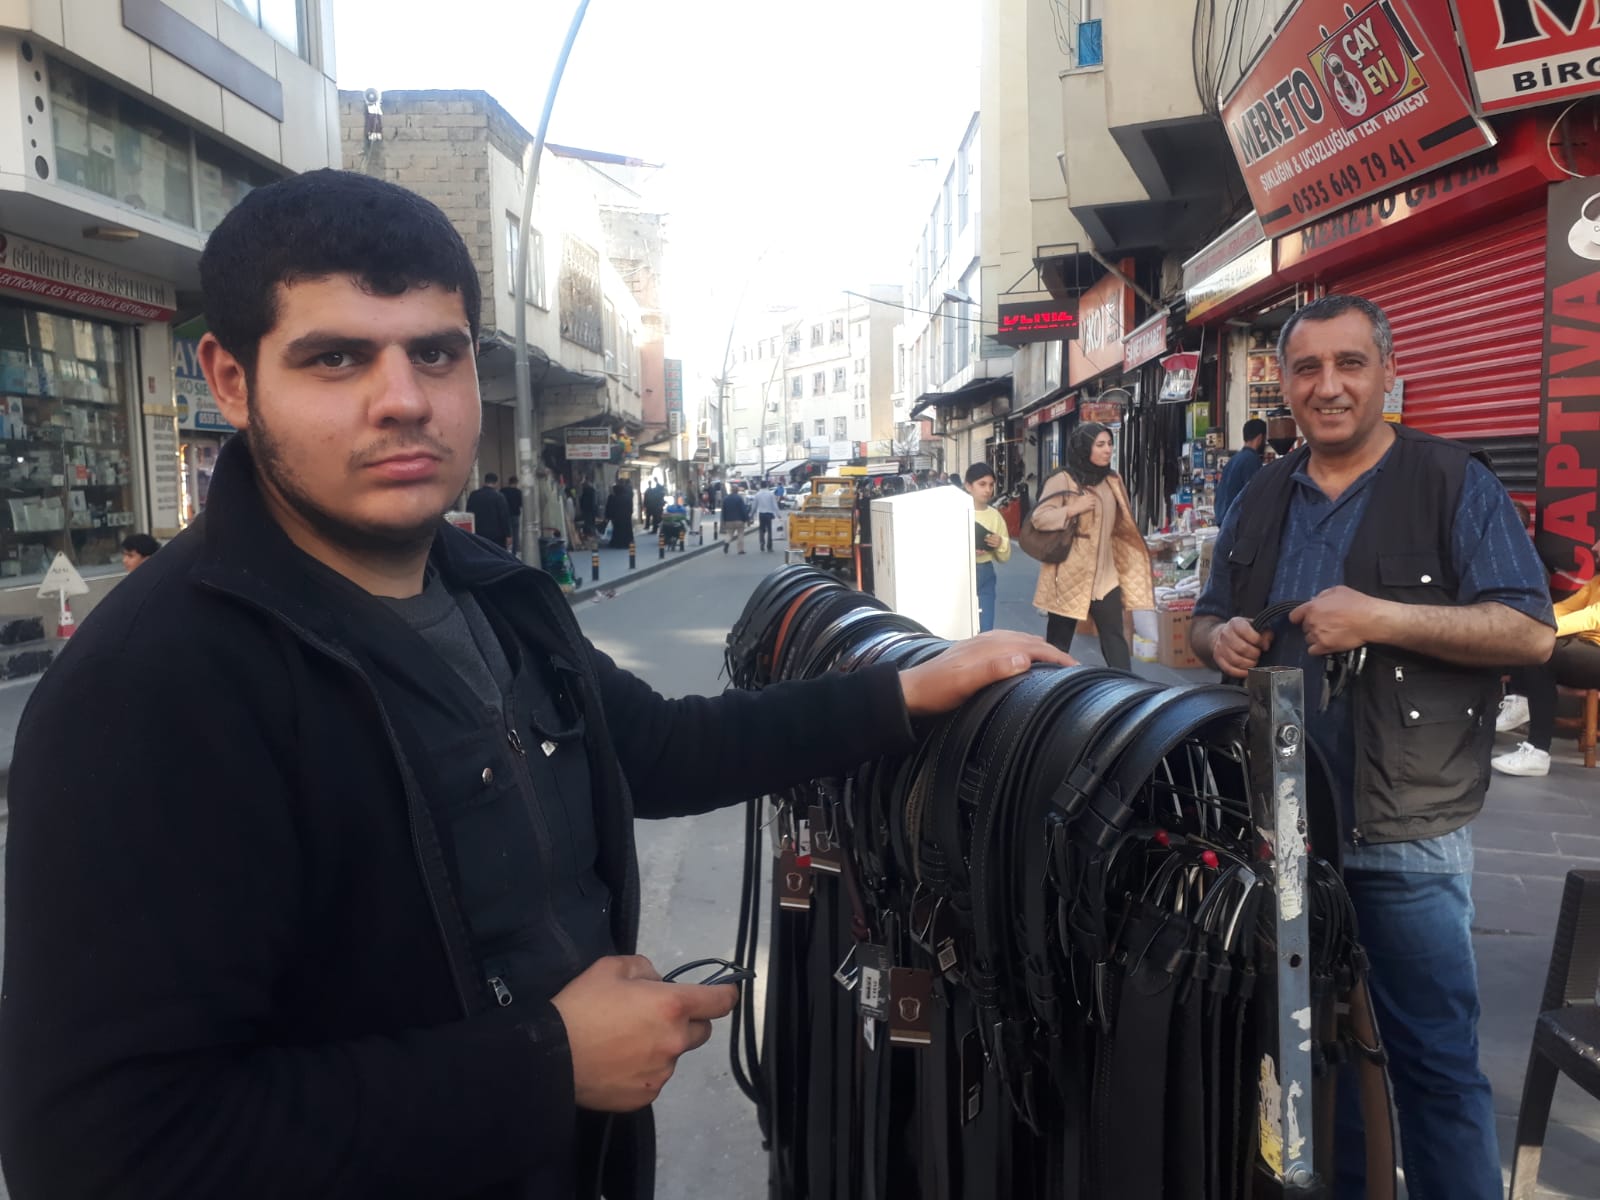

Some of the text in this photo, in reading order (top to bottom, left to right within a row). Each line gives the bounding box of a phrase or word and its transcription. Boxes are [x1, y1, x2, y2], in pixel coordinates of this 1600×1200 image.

[1342, 17, 1379, 68] ÇAY
[1362, 50, 1399, 95] EVİ
[1231, 68, 1324, 167] MERETO
[1291, 156, 1302, 174] &
[1298, 128, 1358, 169] UCUZLUĞUN
[1355, 118, 1381, 138] TEK
[1292, 138, 1416, 214] 0535 649 79 41
[1543, 271, 1600, 591] CAPTIVA
